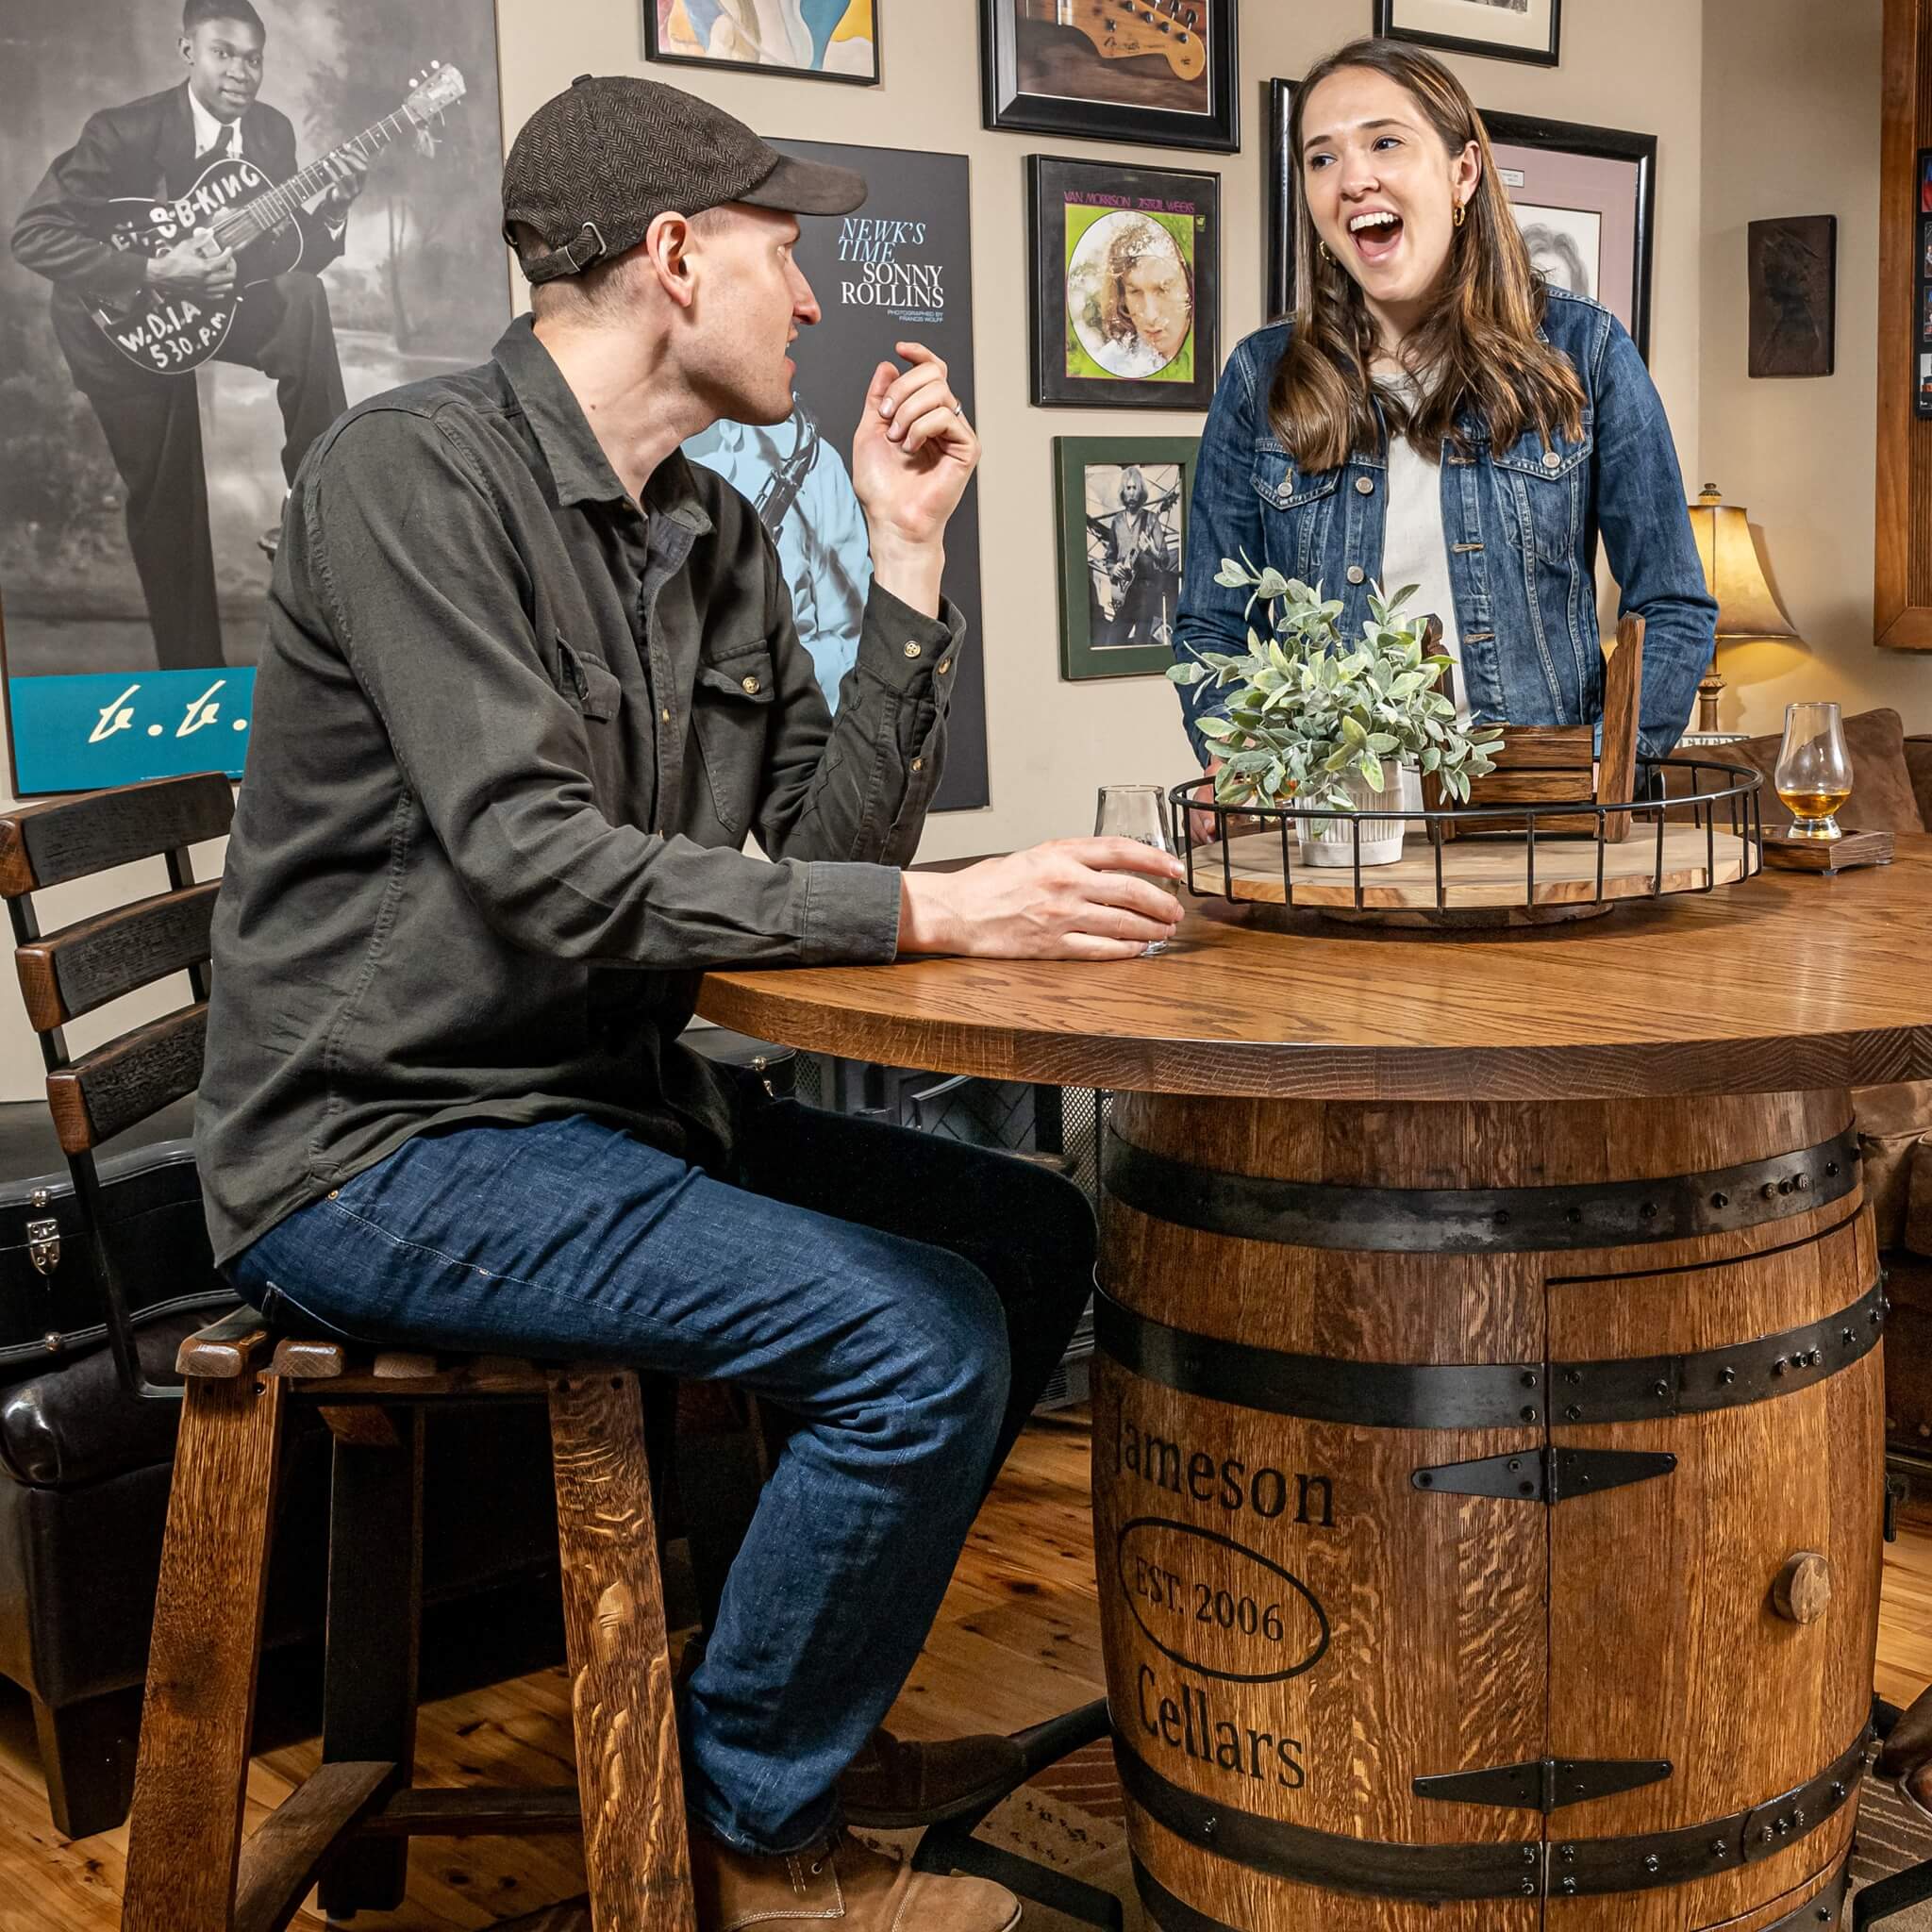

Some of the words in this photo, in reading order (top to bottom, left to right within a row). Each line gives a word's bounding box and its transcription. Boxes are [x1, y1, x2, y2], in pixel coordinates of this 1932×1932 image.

[1064, 191, 1083, 204] VAN
[1086, 193, 1131, 208] MORRISON
[1166, 200, 1196, 214] WEEKS
[840, 217, 926, 245] NEWK'S
[838, 239, 896, 263] TIME
[862, 261, 943, 287] SONNY
[841, 281, 944, 308] ROLLINS
[1115, 1391, 1338, 1528] Jameson
[1136, 1557, 1185, 1615] EST.
[1194, 1583, 1284, 1641] 2006
[1138, 1664, 1306, 1790] Cellars
